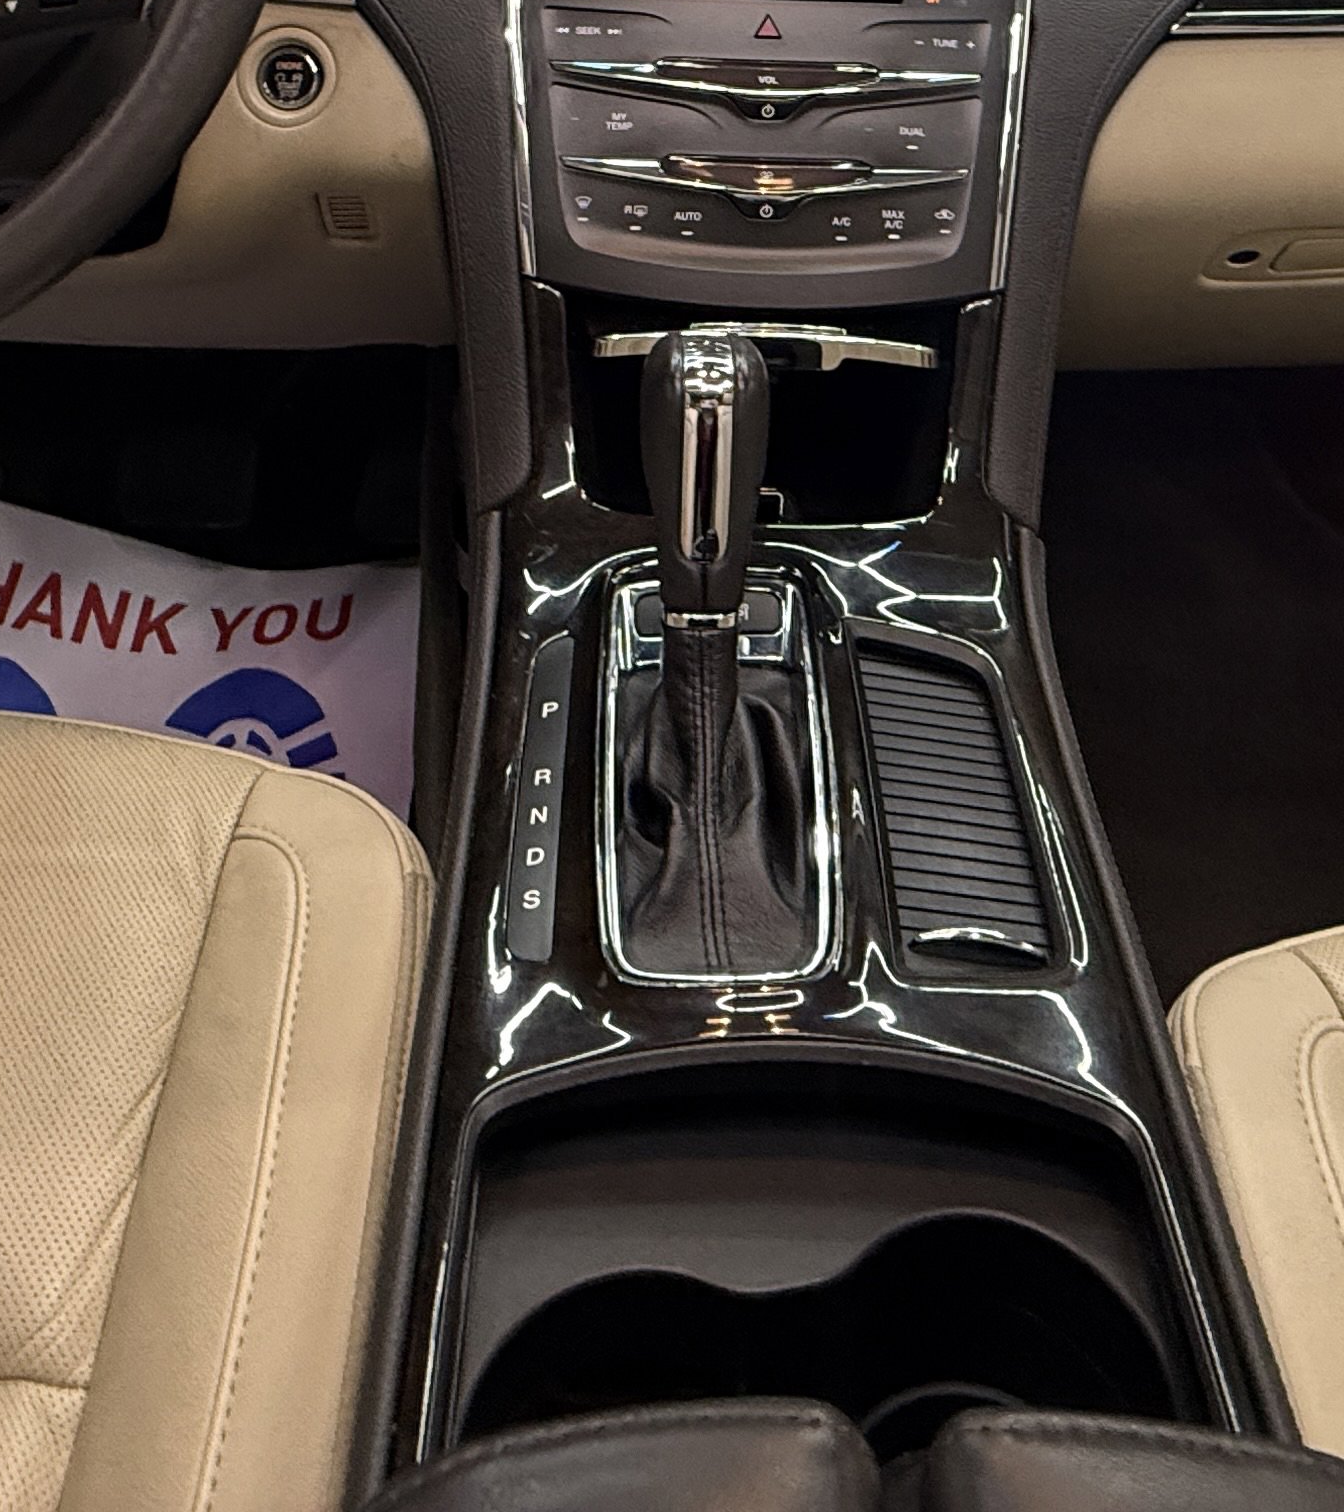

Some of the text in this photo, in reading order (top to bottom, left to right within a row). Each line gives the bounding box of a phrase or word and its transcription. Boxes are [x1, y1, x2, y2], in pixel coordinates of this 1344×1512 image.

[575, 26, 602, 35] SEEK
[932, 38, 959, 48] TUNE
[758, 75, 779, 85] VOL
[612, 112, 627, 121] MY
[606, 121, 633, 131] TEMP
[899, 126, 926, 137] DUAL
[674, 211, 702, 221] AUTO
[881, 209, 905, 219] MAX
[832, 217, 852, 227] A/C
[884, 219, 903, 230] A/C
[211, 593, 354, 652] YOU
[542, 701, 559, 719] P
[534, 769, 552, 786] R
[530, 806, 548, 825] N
[526, 847, 545, 867] D
[522, 890, 541, 909] S
